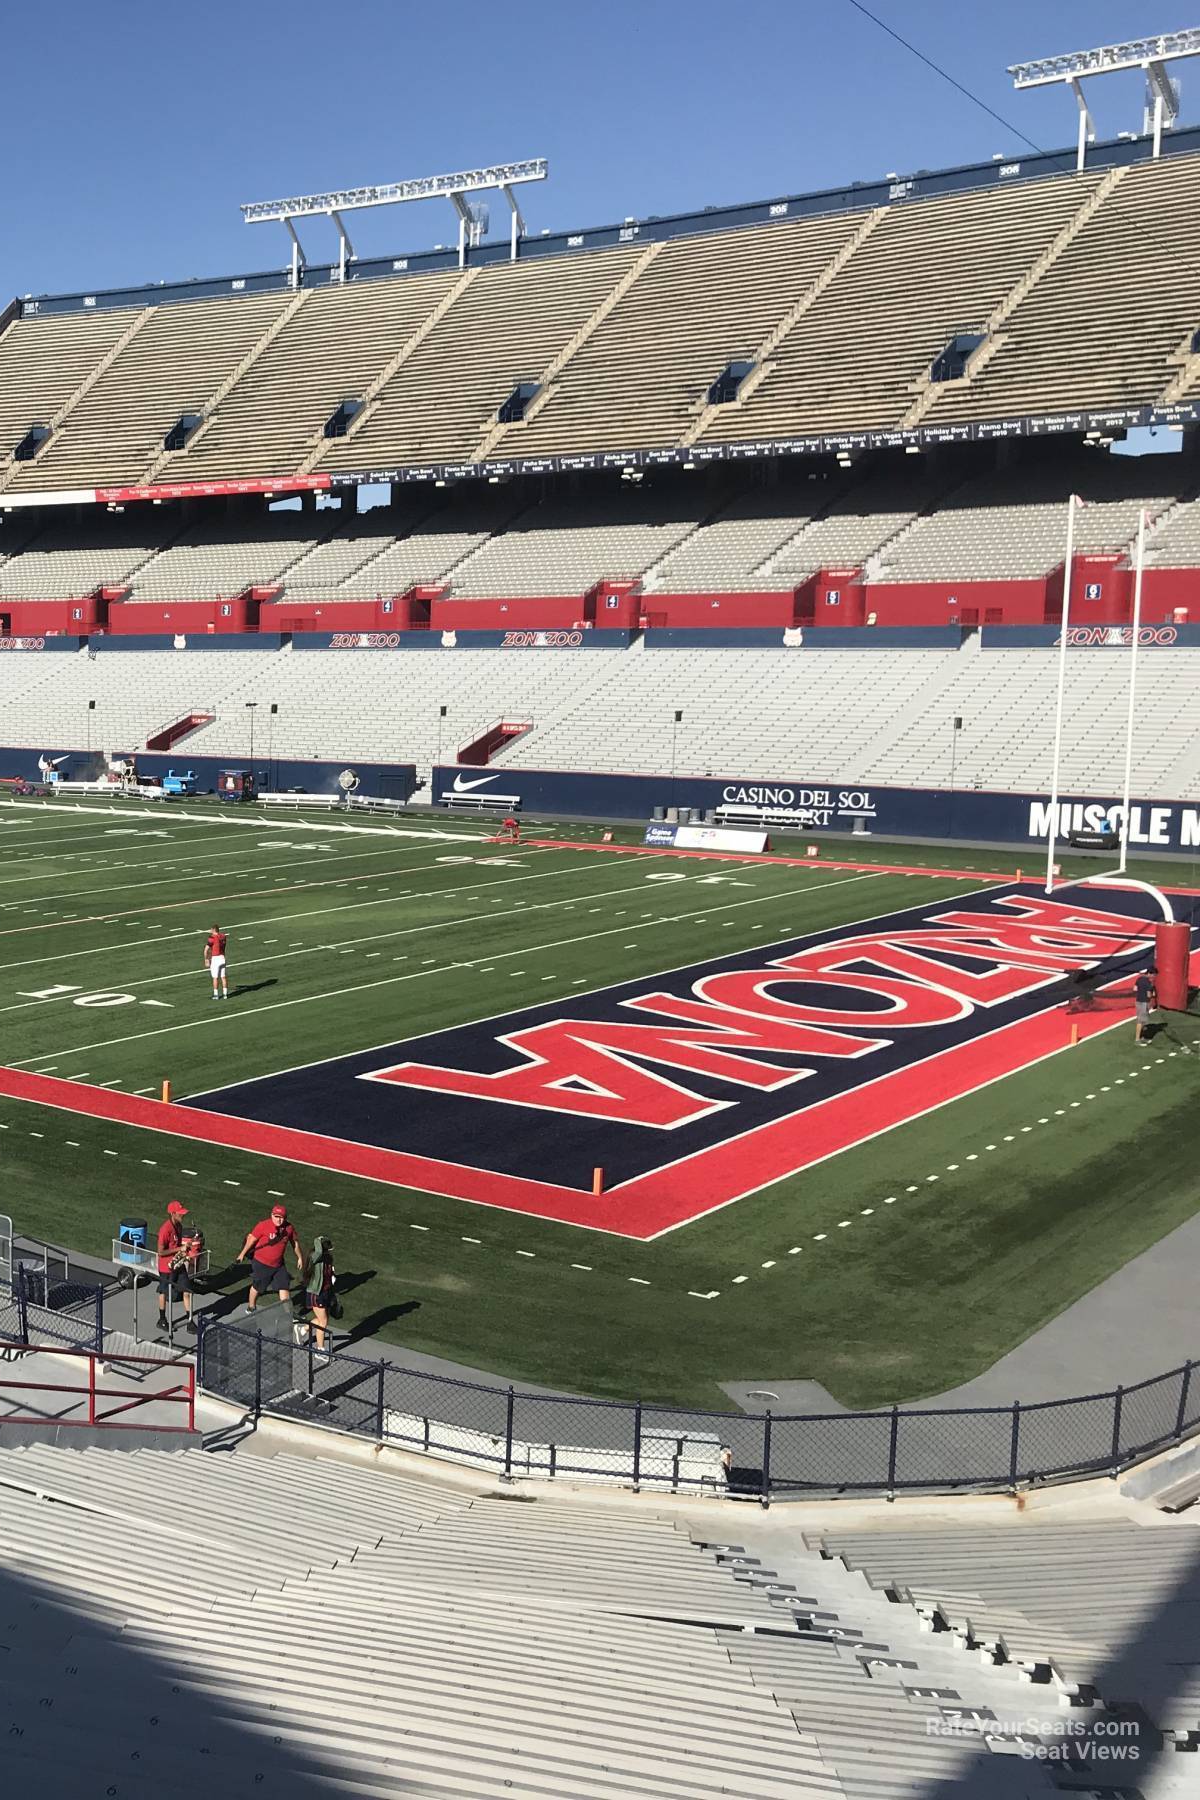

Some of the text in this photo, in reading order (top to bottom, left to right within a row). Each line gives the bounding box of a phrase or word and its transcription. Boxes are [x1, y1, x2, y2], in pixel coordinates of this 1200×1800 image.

[1175, 405, 1193, 413] Bowl
[1088, 412, 1126, 420] Independence
[924, 426, 969, 436] Holiday Bowl
[978, 421, 1021, 431] Alamo Bowl
[824, 437, 849, 445] Holiday
[882, 432, 901, 440] Vegas
[722, 786, 876, 810] CASINO DEL SOL
[1028, 801, 1172, 845] MUSCLE
[651, 826, 672, 836] Game
[646, 833, 675, 843] Sponsor
[15, 984, 137, 1008] 10
[356, 894, 1200, 1131] ARIZONA
